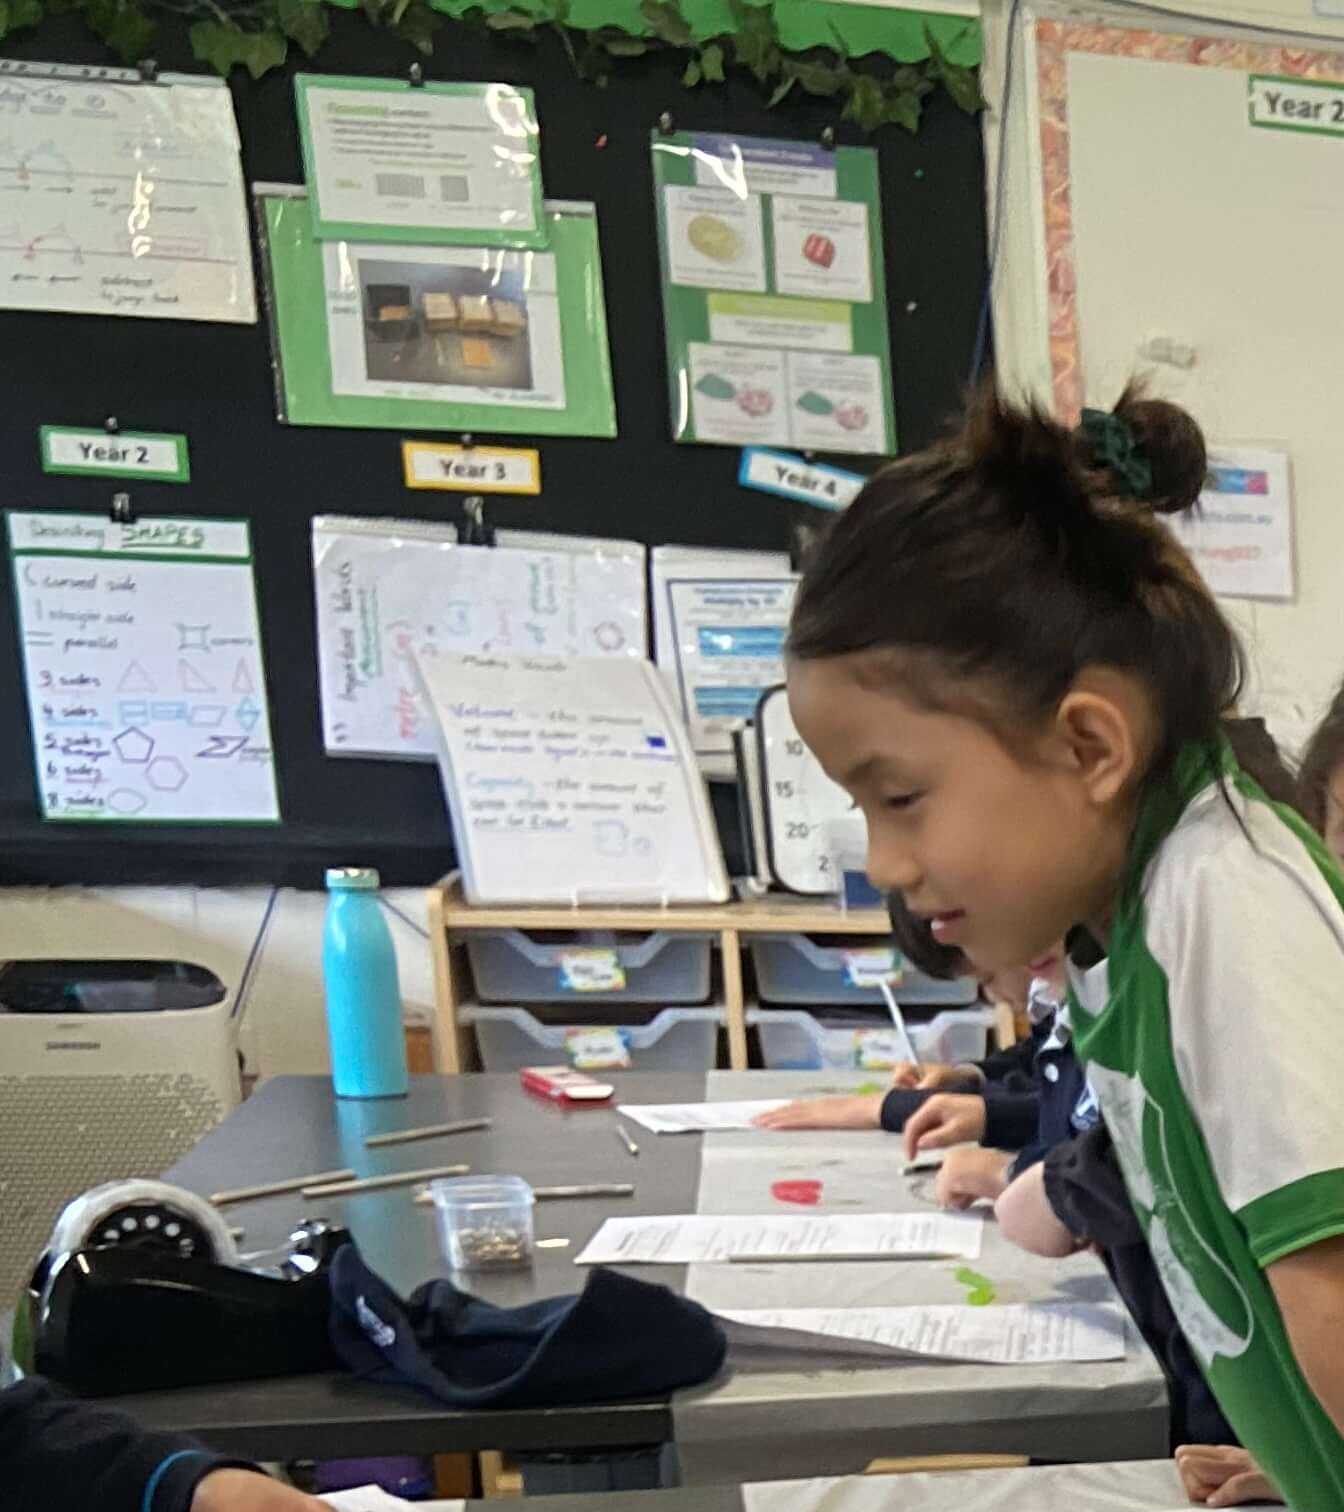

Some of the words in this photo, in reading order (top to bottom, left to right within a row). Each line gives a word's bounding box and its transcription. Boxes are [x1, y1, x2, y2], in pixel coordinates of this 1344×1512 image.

[1263, 91, 1323, 121] Year
[79, 442, 131, 462] Year
[136, 446, 150, 463] 2
[439, 458, 487, 480] Year
[494, 462, 507, 481] 3
[774, 464, 820, 492] Year
[823, 480, 838, 498] 4
[784, 738, 804, 756] 10
[774, 780, 794, 798] 15
[786, 821, 811, 839] 20
